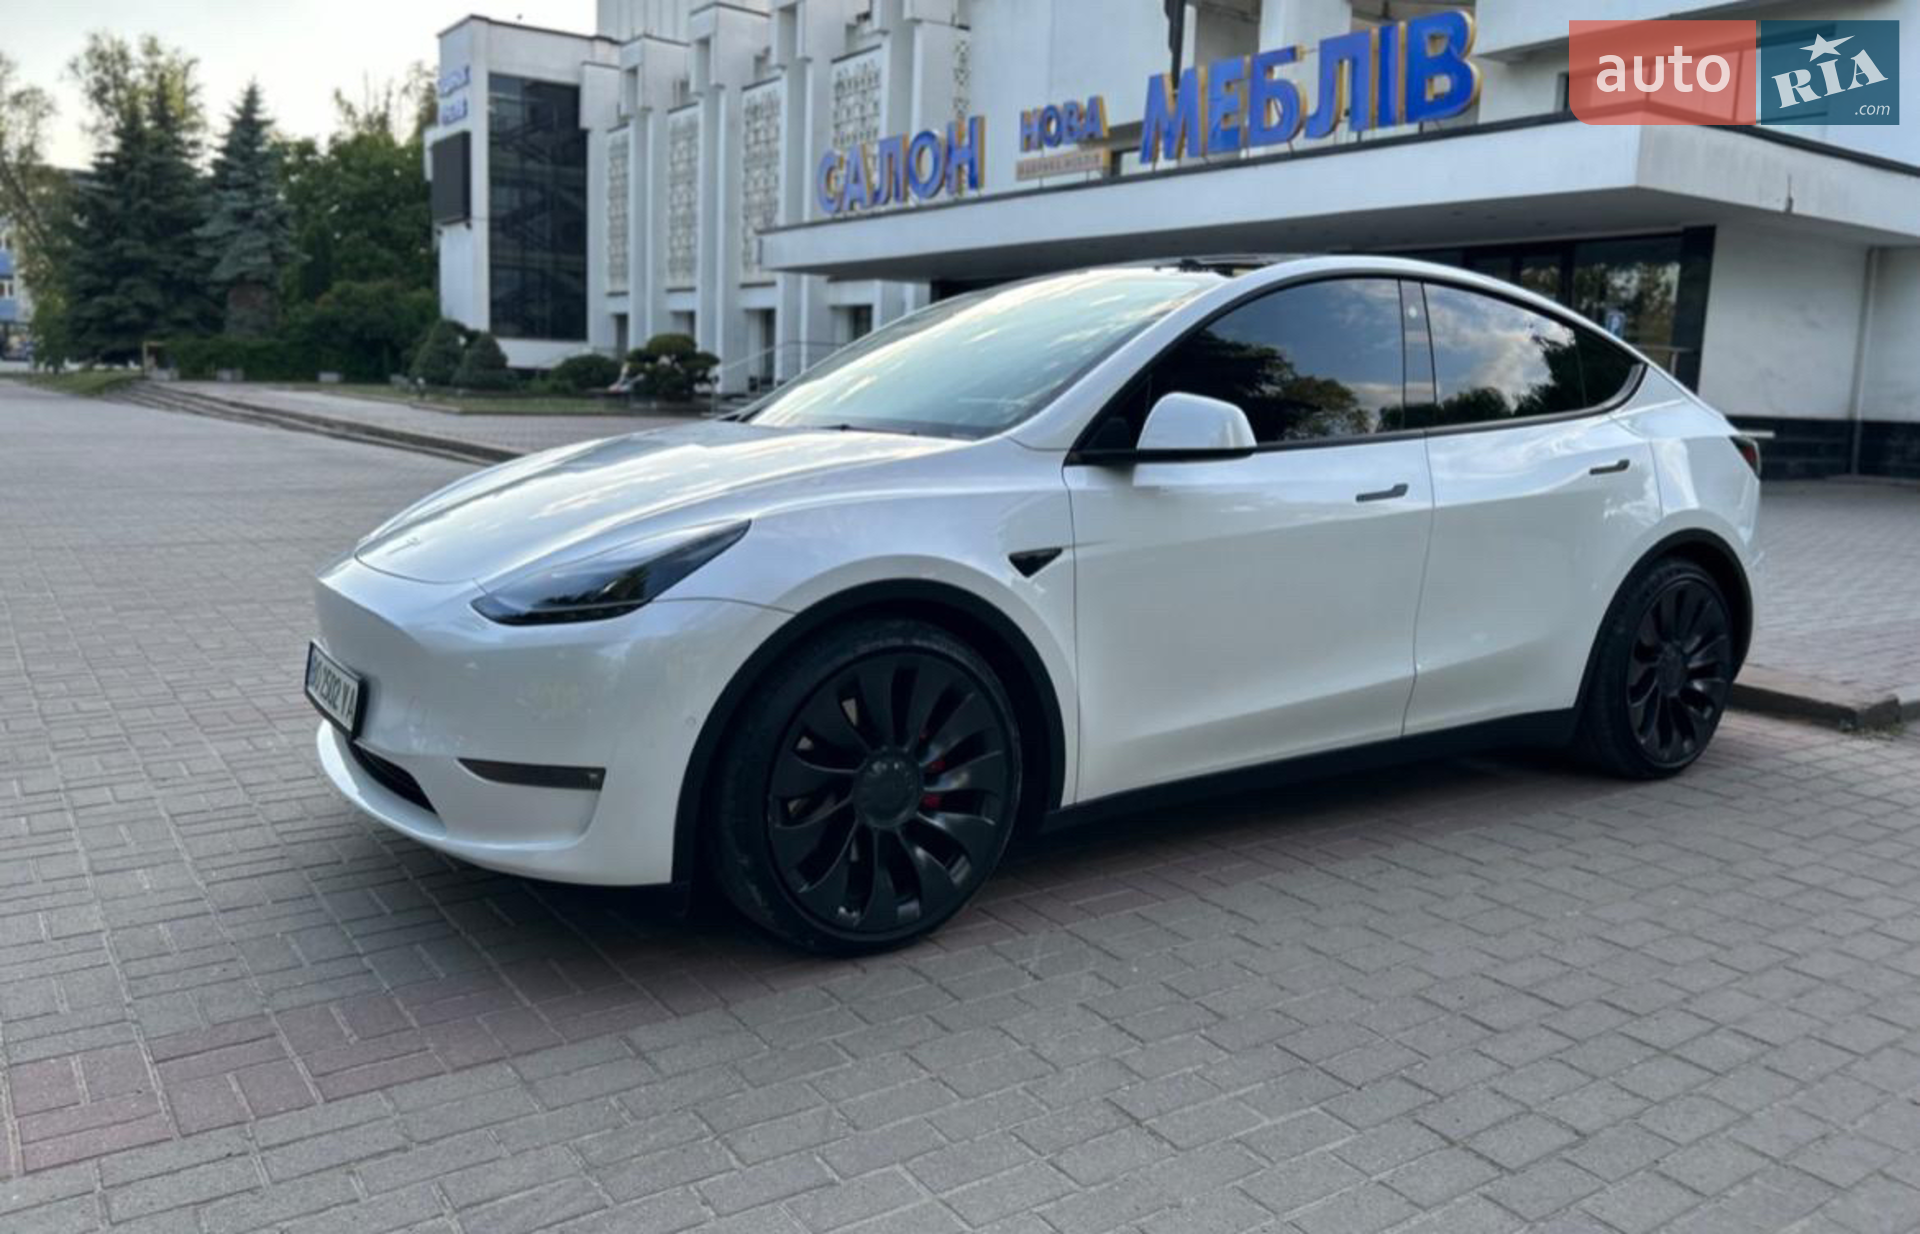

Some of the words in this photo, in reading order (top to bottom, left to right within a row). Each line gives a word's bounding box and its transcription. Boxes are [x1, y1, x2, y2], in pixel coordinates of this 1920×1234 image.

[816, 115, 985, 213] САЛОН
[1140, 10, 1482, 164] МЕБЛІВ
[1020, 95, 1108, 153] НОВА
